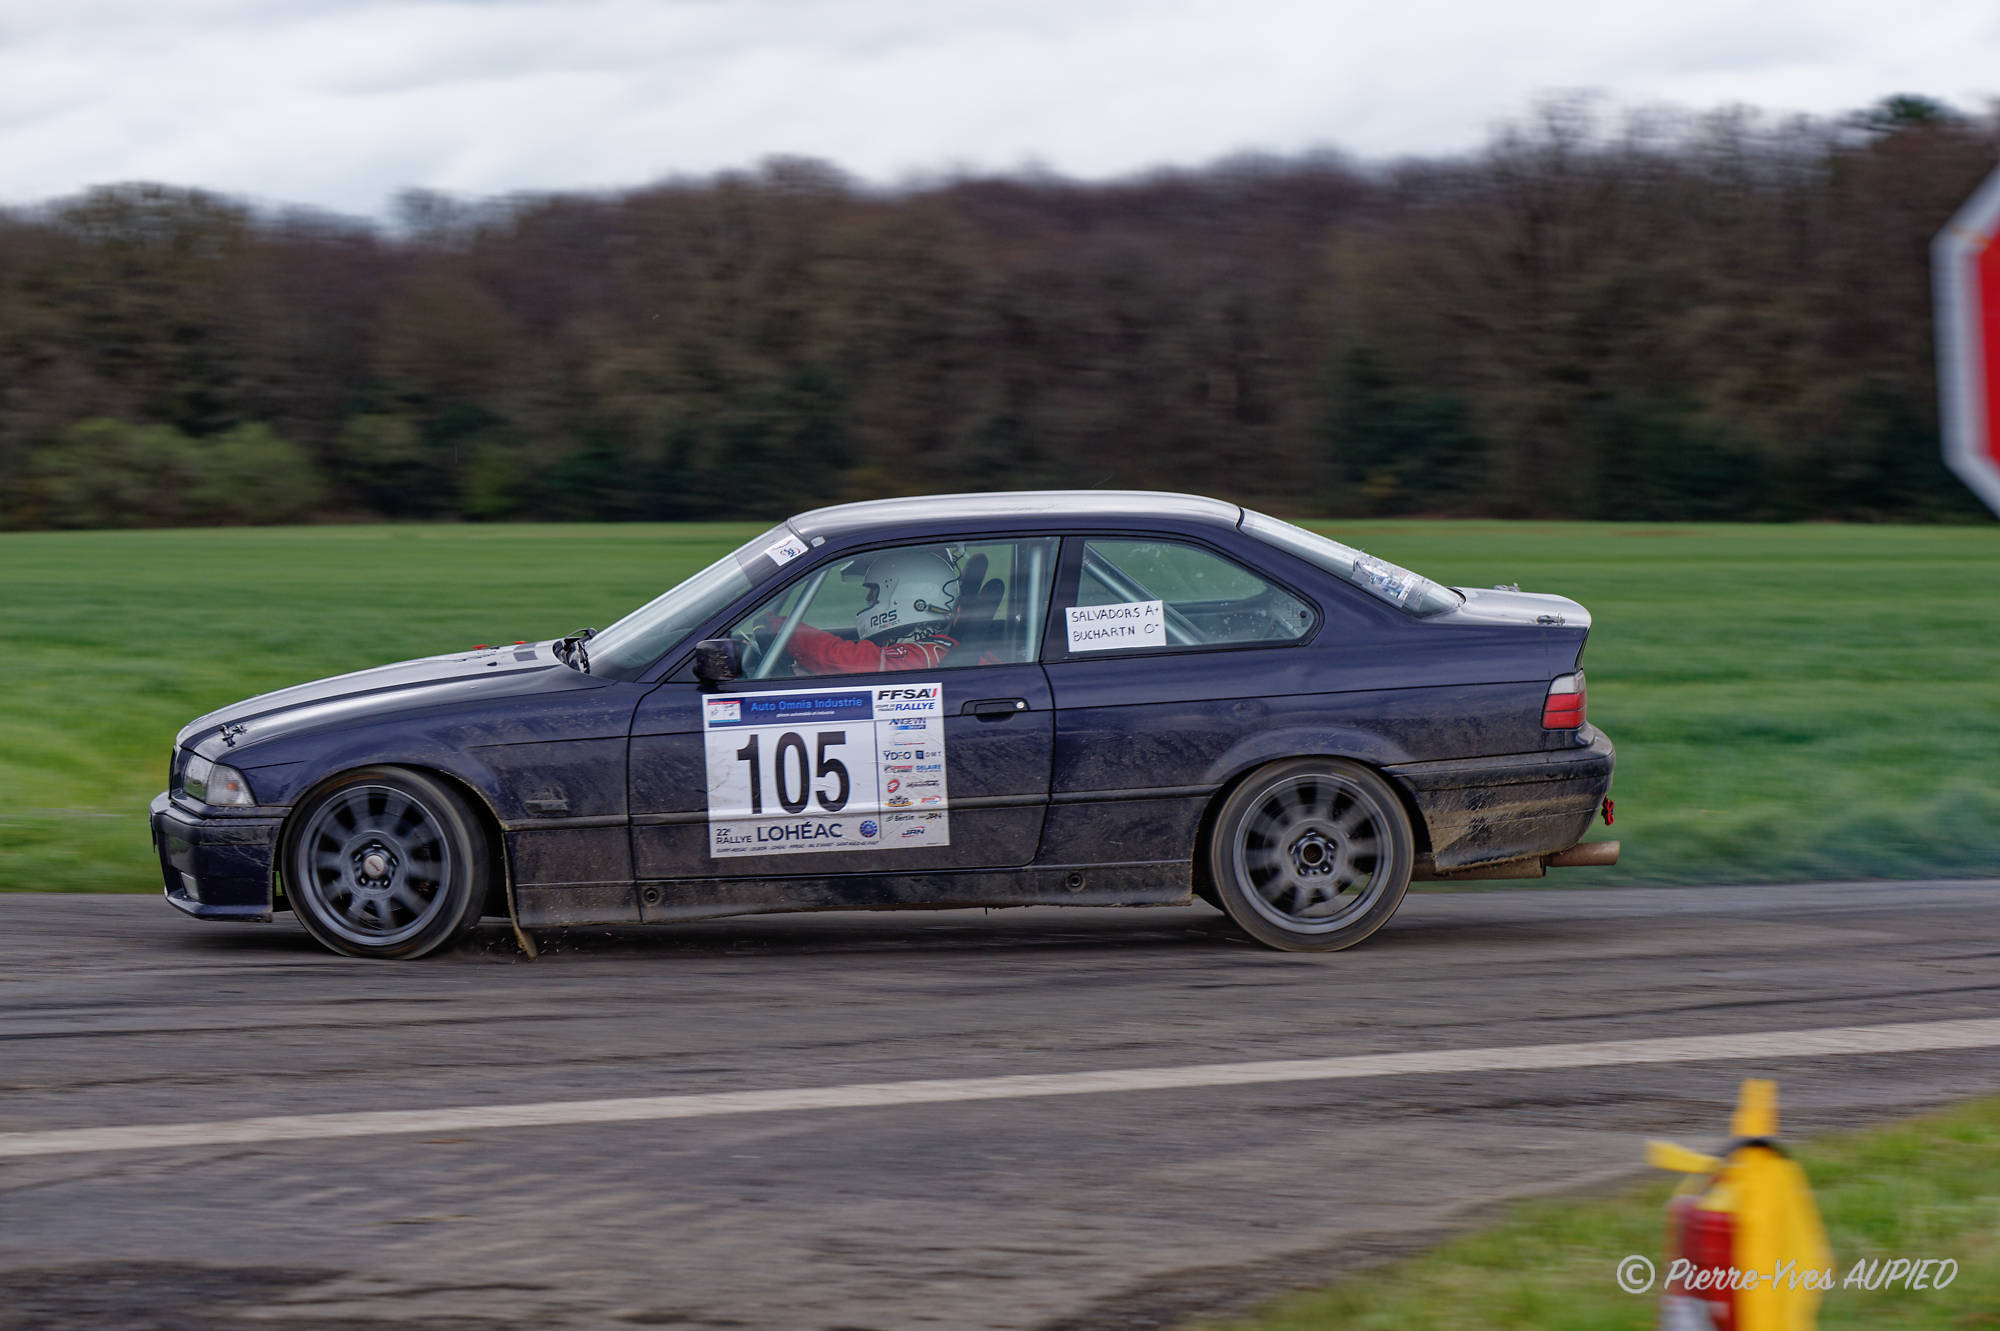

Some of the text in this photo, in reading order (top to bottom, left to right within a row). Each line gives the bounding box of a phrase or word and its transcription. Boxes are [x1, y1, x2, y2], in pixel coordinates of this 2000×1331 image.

[871, 609, 898, 628] RRS
[877, 688, 931, 700] FFSA
[751, 702, 776, 712] Auto
[778, 699, 812, 711] Omnia
[814, 697, 863, 709] Industrie
[895, 702, 935, 711] RALLYE
[736, 731, 850, 815] 105
[757, 821, 843, 842] LOHÉAC
[716, 836, 752, 845] RALLYE
